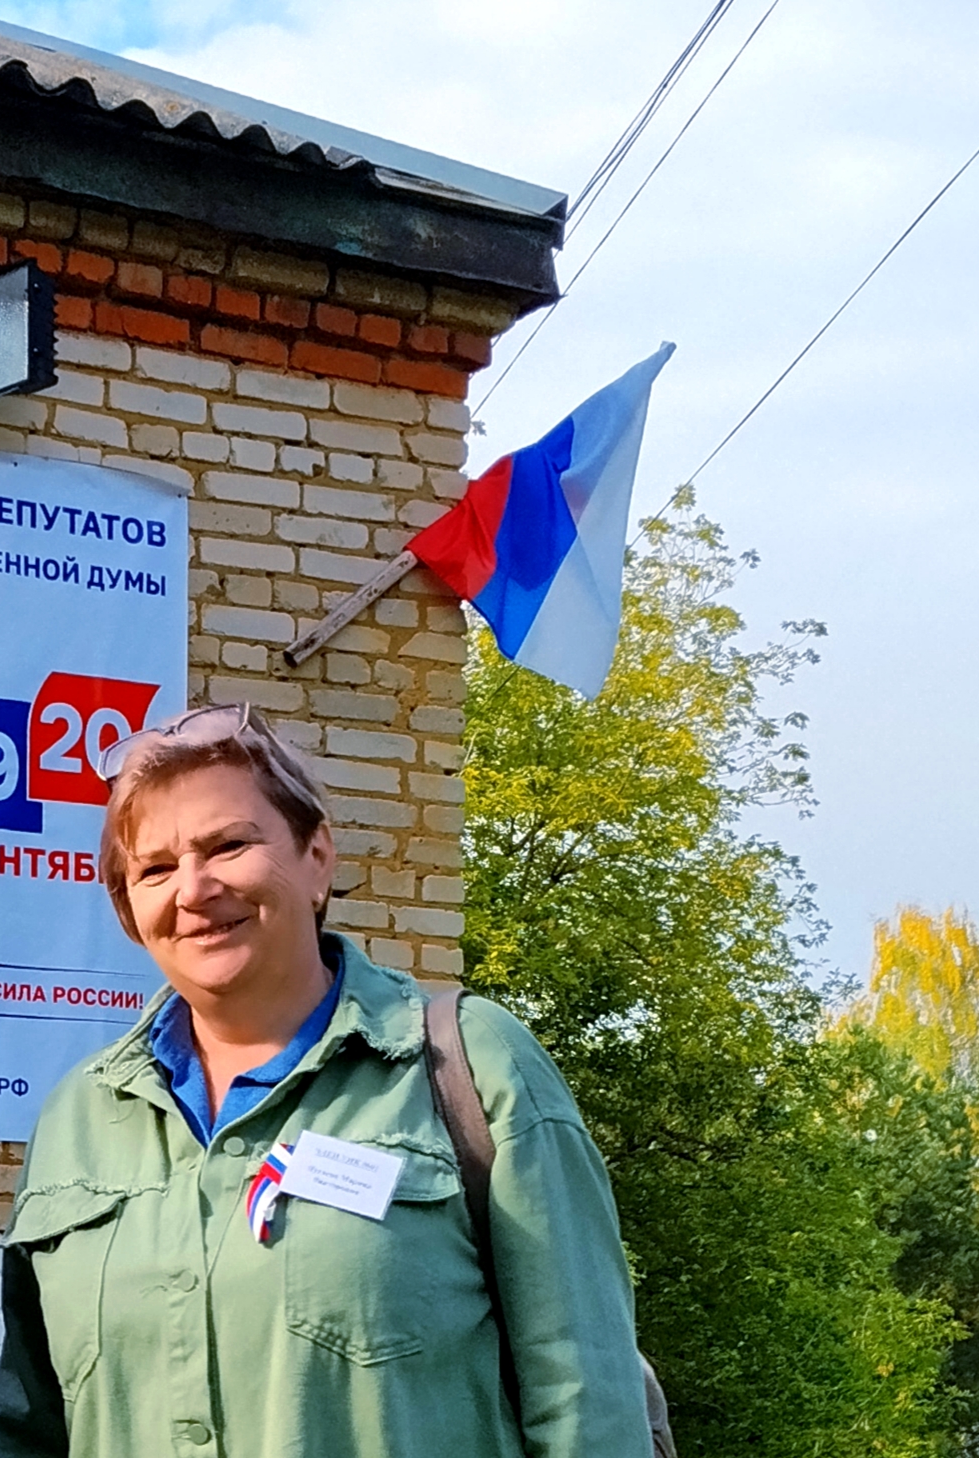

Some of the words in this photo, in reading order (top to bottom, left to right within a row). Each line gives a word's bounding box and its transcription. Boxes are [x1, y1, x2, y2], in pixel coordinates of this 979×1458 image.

[87, 565, 166, 596] ДУМЫ
[39, 702, 133, 780] 20
[53, 986, 144, 1010] РОССИИ!
